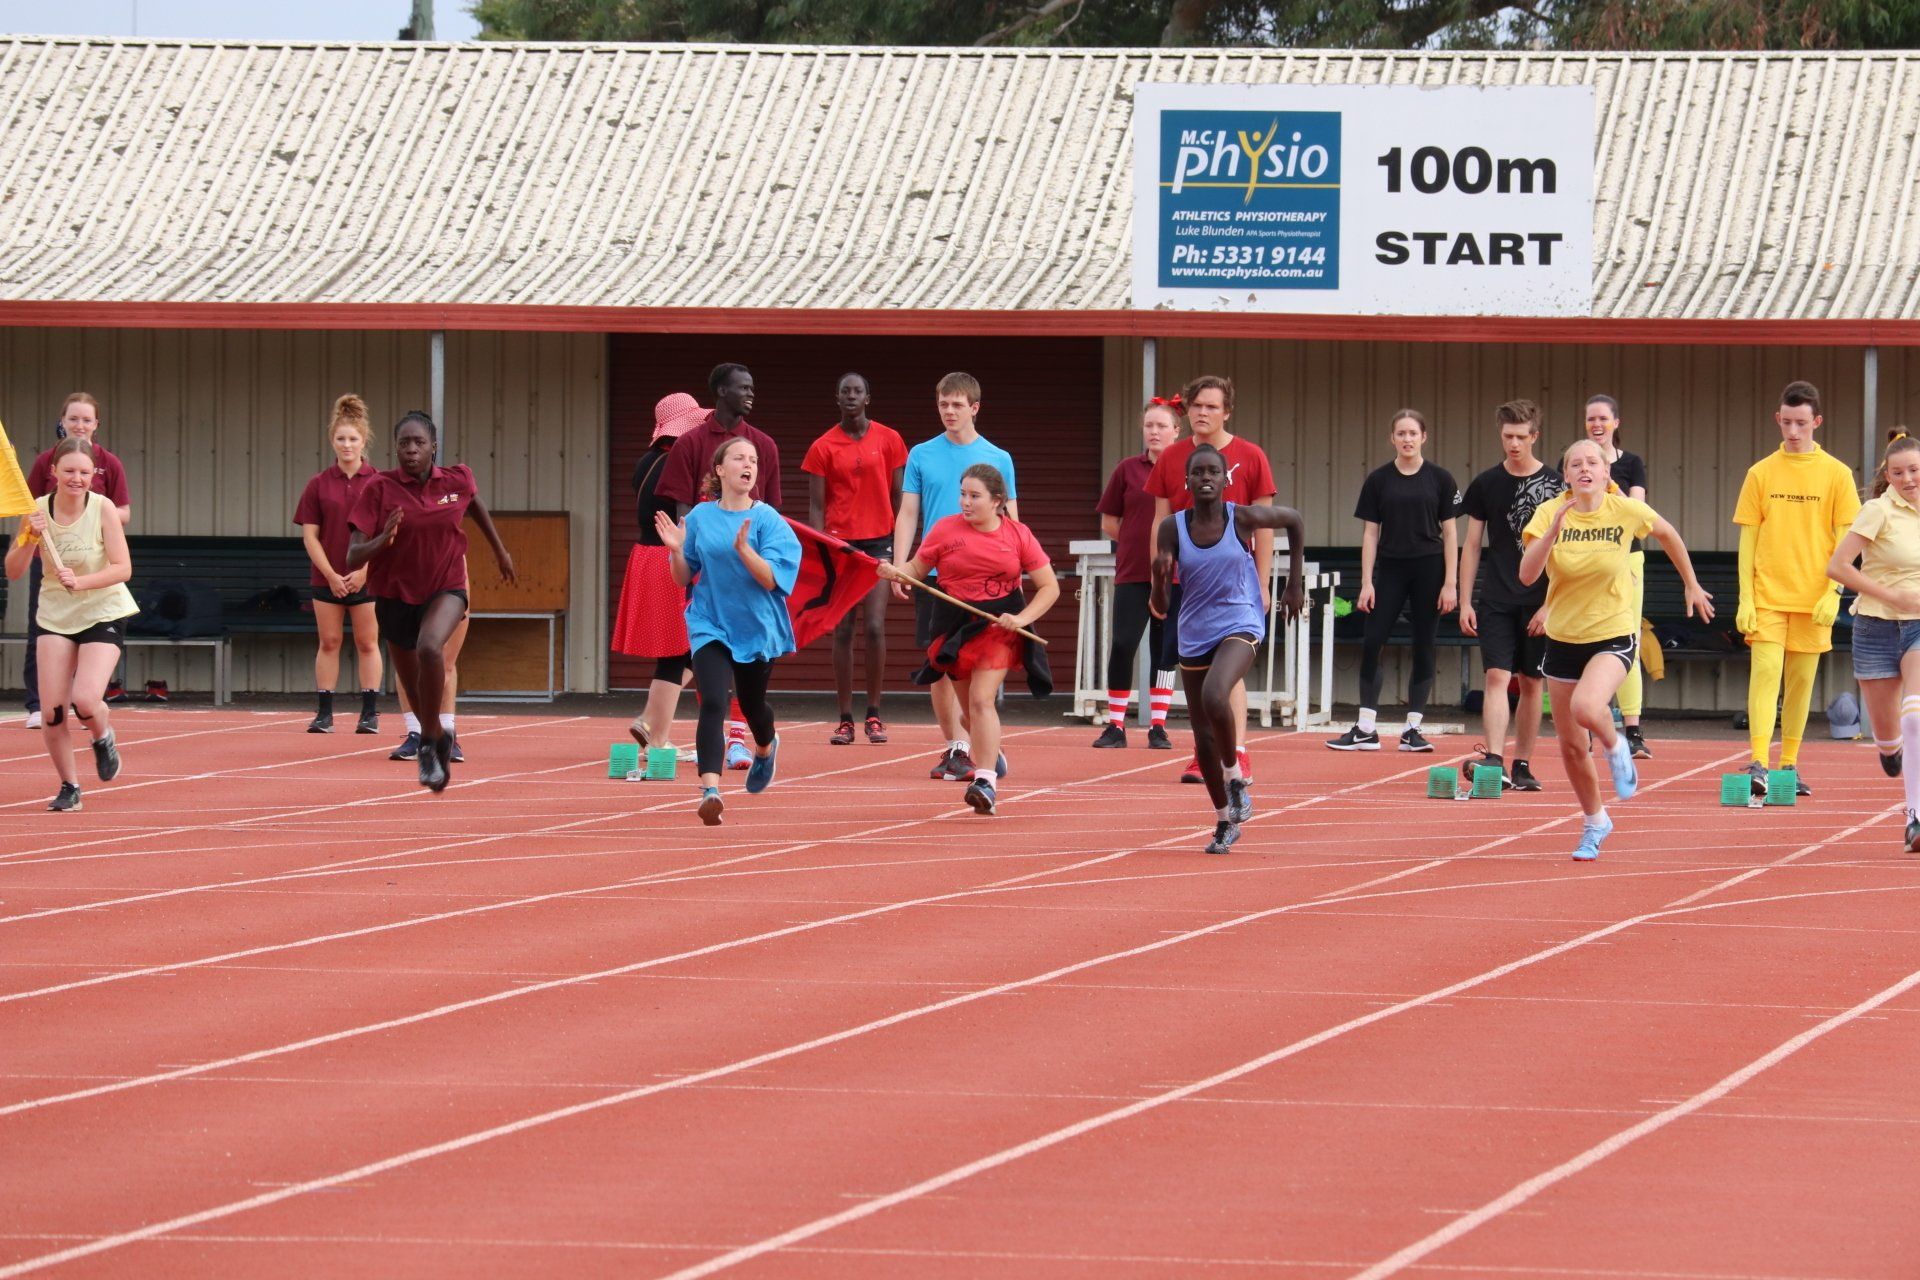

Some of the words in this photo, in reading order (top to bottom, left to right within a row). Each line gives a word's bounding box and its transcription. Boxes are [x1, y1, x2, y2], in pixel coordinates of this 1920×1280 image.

[1180, 129, 1215, 146] M.C.
[1377, 145, 1557, 194] 100m
[1171, 210, 1231, 222] ATHLETICS
[1235, 211, 1327, 223] PHYSIOTHERAPY
[1175, 225, 1200, 236] Luke
[1201, 225, 1244, 237] Blunden
[1259, 230, 1277, 238] Sports
[1277, 230, 1321, 239] Physiotherapist
[1172, 244, 1208, 264] Ph:
[1211, 245, 1265, 265] 5331
[1271, 246, 1326, 265] 9144
[1375, 231, 1563, 265] START
[1171, 265, 1324, 280] www.mcphysio.com.au
